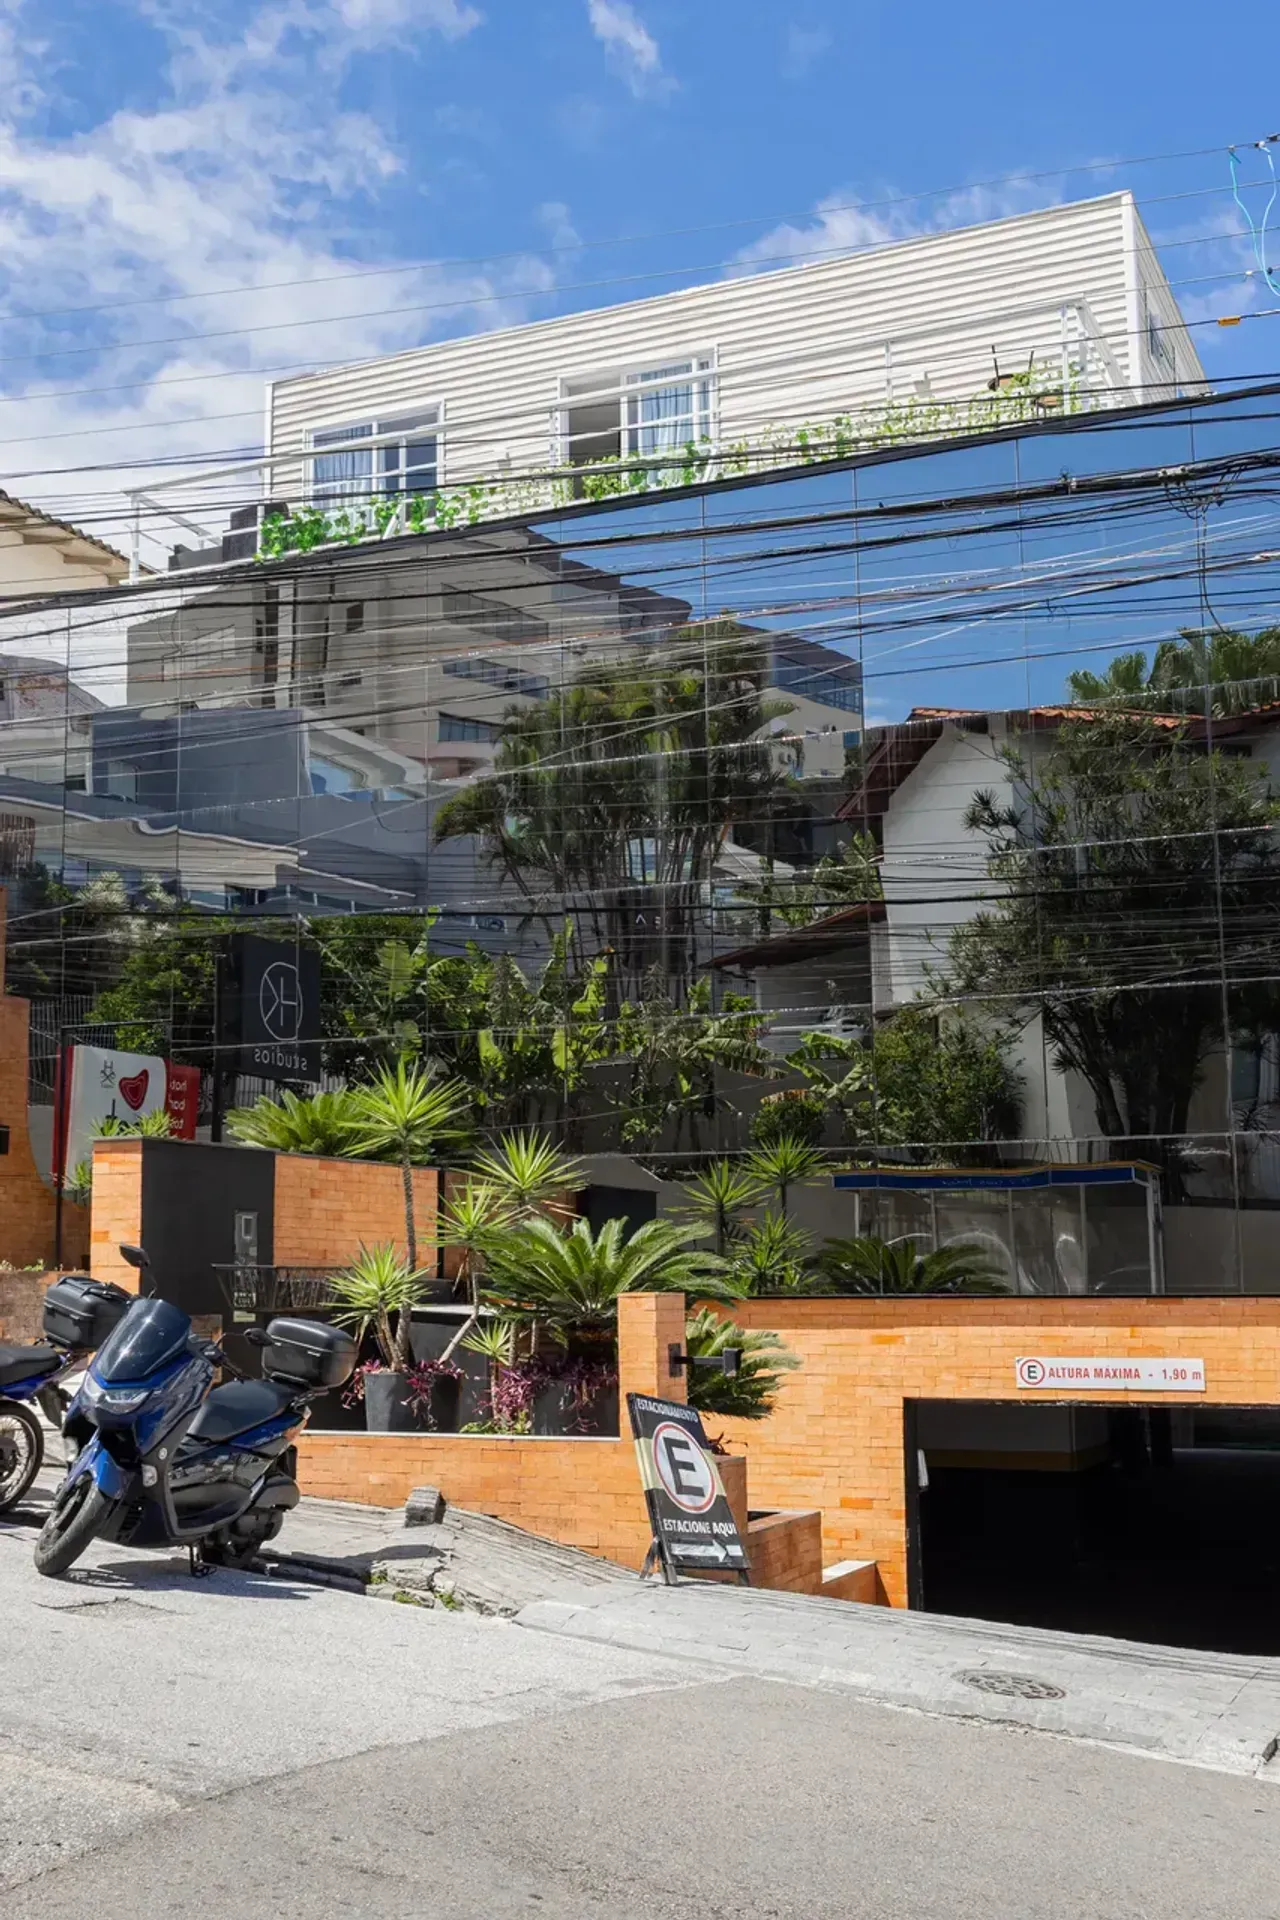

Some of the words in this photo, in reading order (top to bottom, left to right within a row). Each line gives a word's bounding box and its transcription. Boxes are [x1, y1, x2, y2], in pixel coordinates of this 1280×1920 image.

[1027, 1365, 1037, 1379] E
[1048, 1367, 1090, 1379] ALTURA
[1192, 1371, 1201, 1380] m
[636, 1398, 699, 1423] ESTACIONAMENTO
[662, 1436, 705, 1497] E
[663, 1518, 711, 1535] ESTACIONE
[712, 1521, 738, 1535] AQUI
